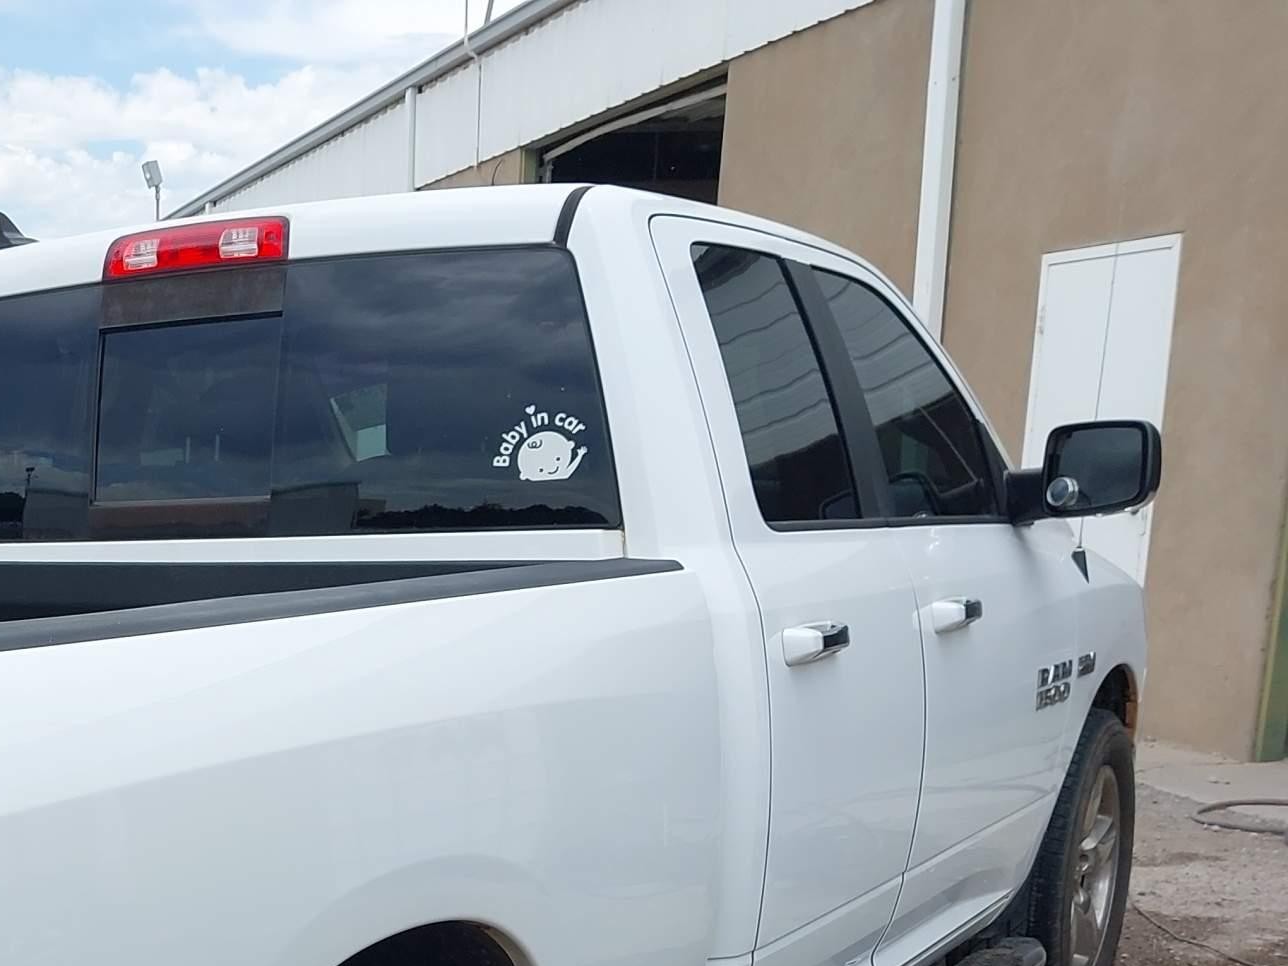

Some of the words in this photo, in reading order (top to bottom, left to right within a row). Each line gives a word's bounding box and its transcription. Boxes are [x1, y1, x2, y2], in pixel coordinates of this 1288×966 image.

[493, 420, 528, 467] Baby
[526, 406, 549, 428] in
[554, 412, 586, 434] car
[1037, 659, 1073, 689] RAM
[1035, 681, 1071, 711] 1500
